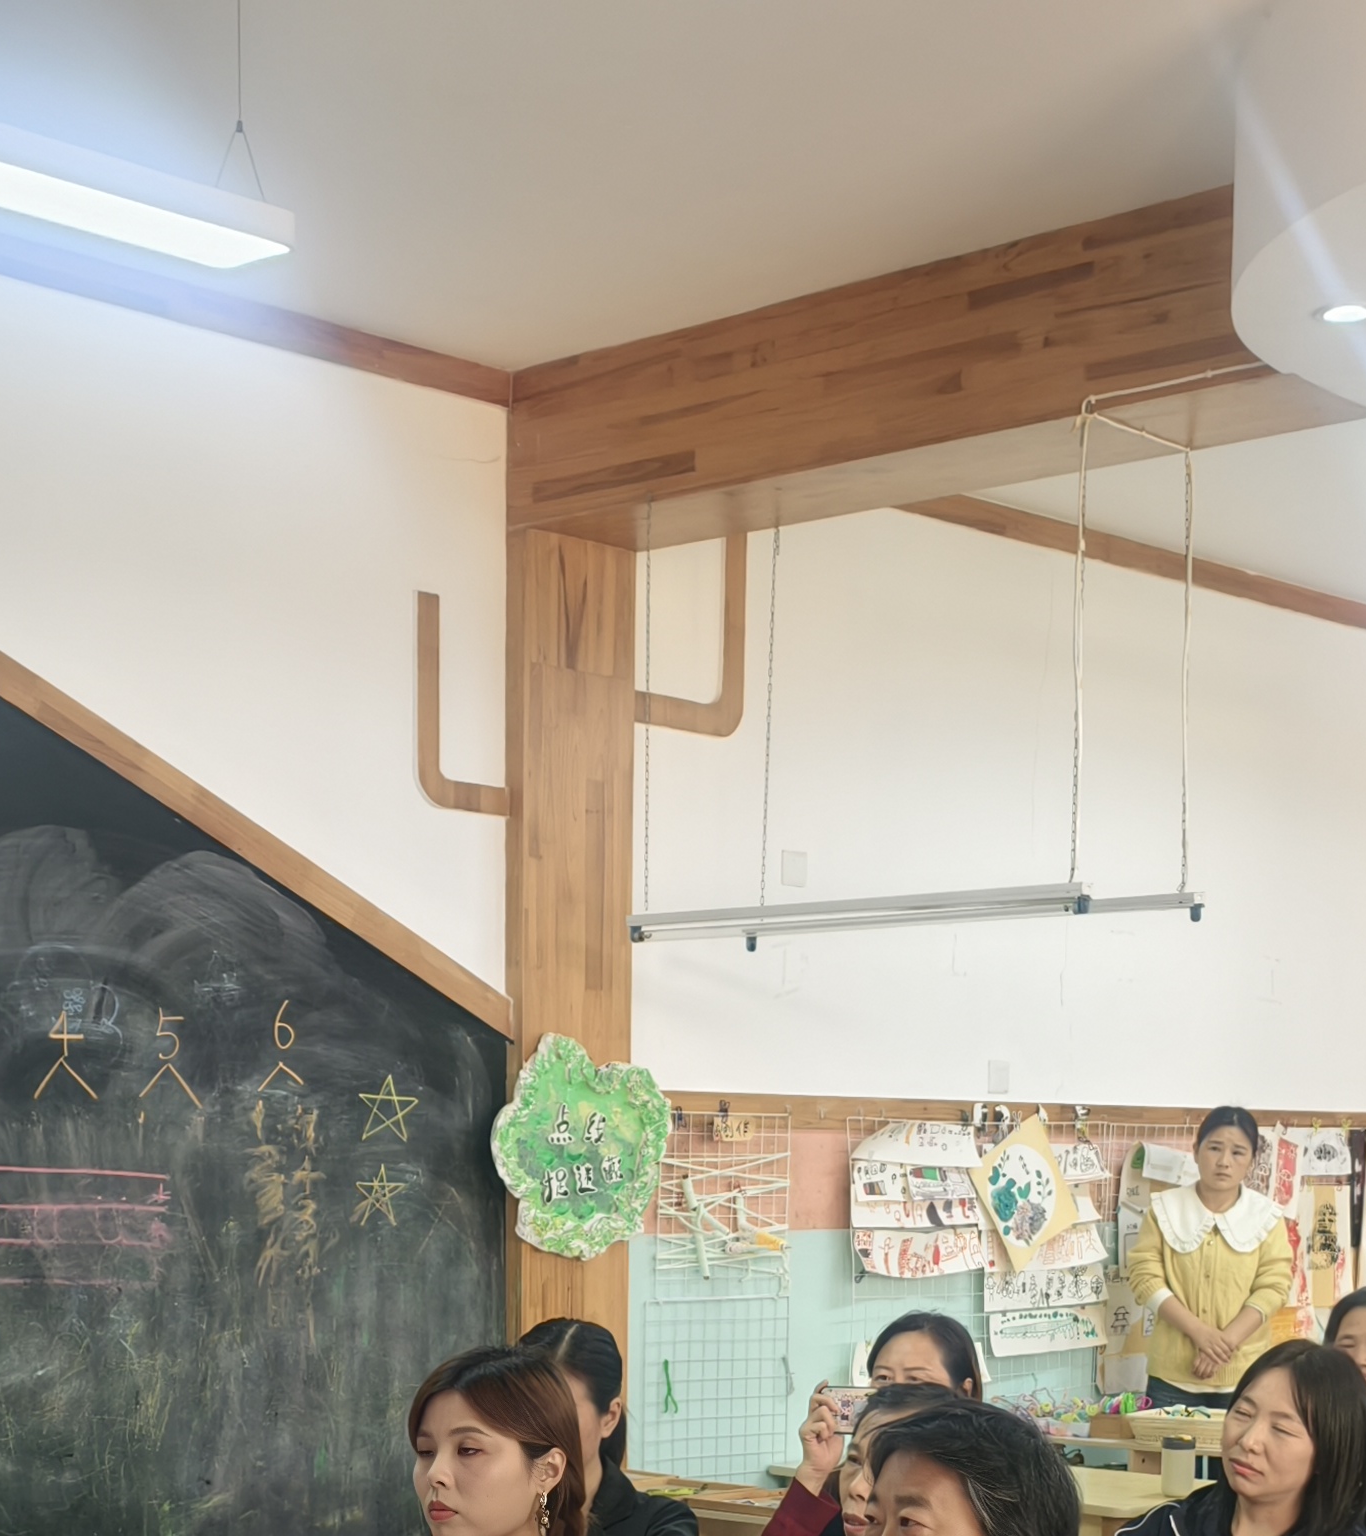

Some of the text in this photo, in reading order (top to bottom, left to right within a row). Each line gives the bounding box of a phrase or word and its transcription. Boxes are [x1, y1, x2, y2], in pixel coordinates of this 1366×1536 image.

[48, 1010, 84, 1058] 4
[156, 1006, 184, 1060] 5
[273, 999, 295, 1050] 6
